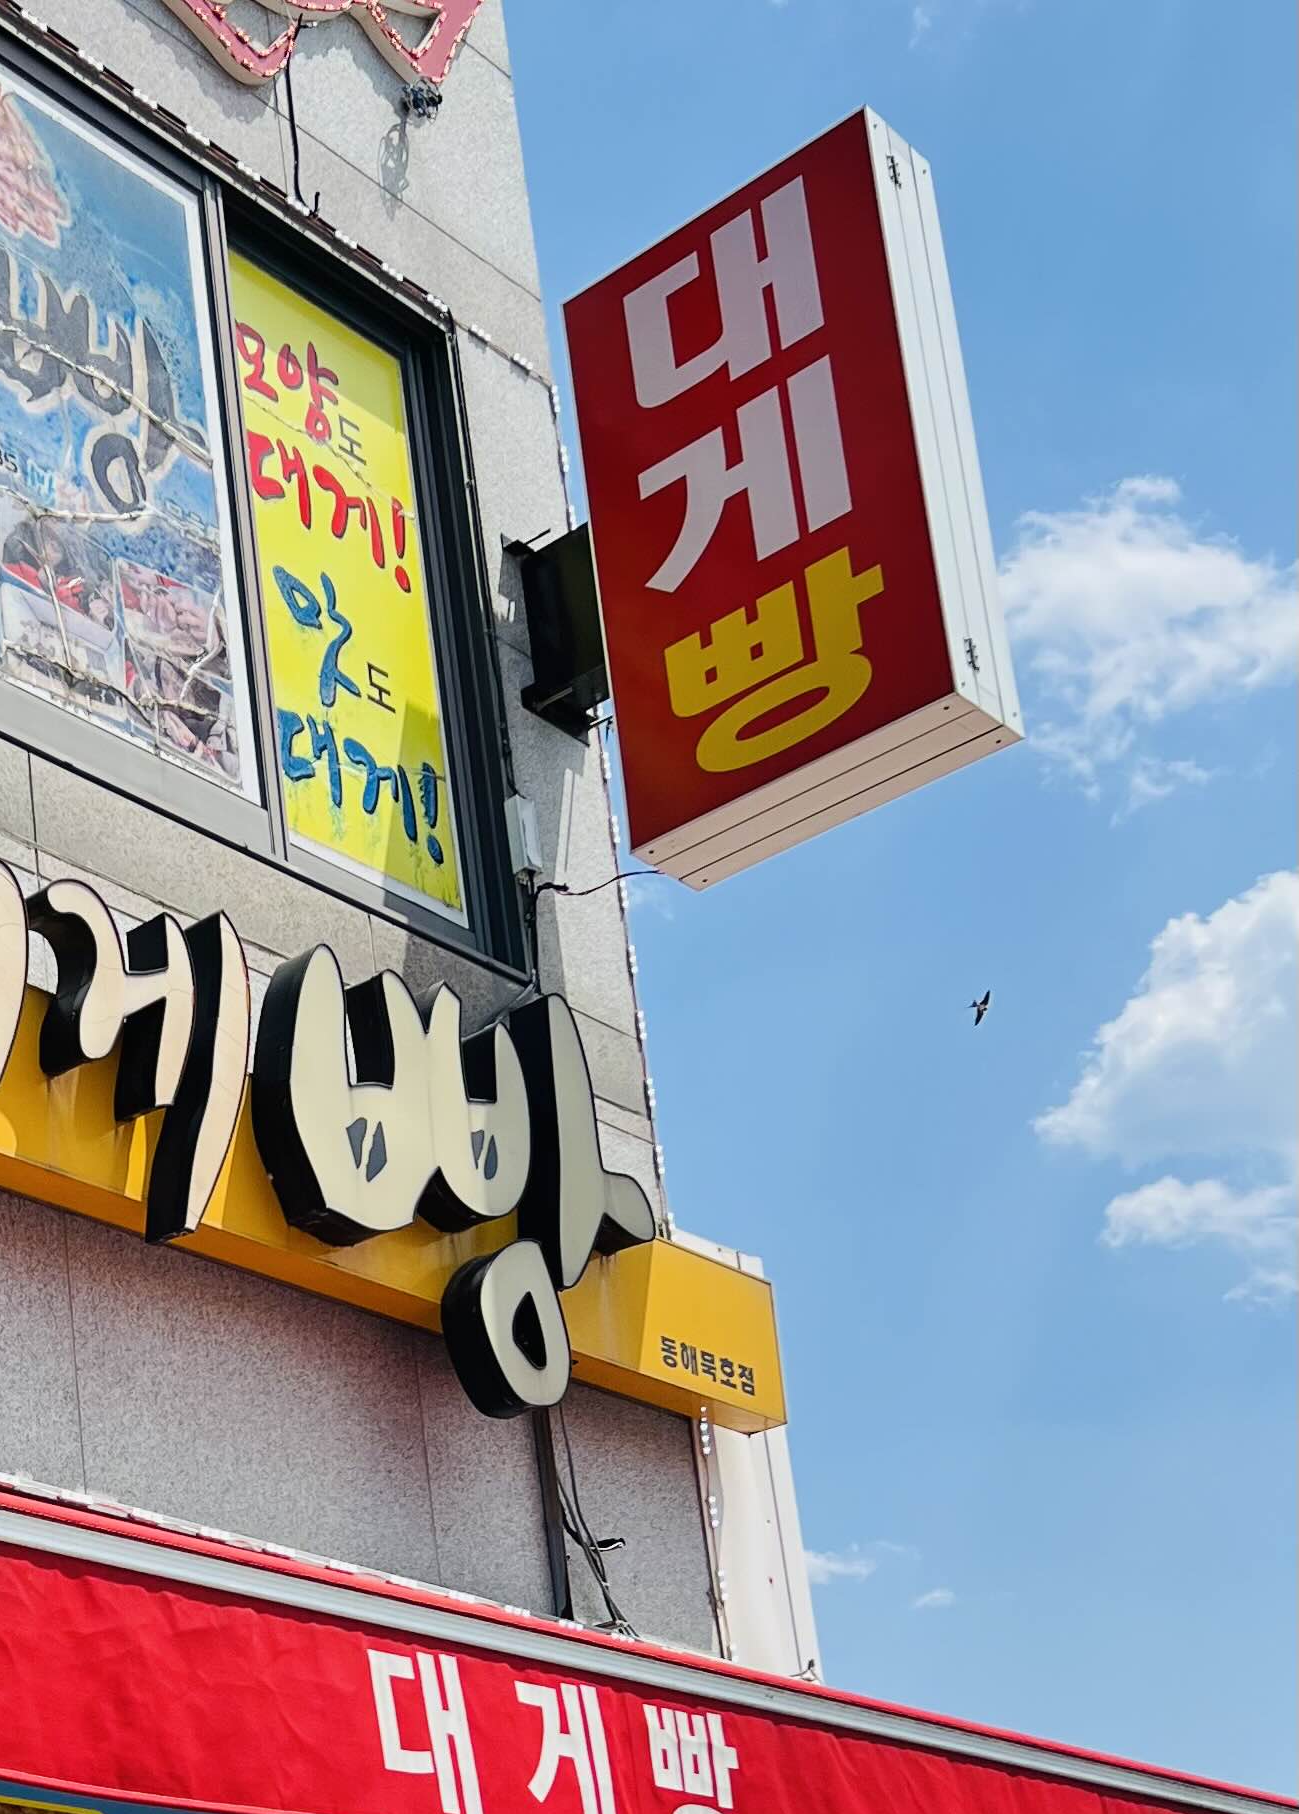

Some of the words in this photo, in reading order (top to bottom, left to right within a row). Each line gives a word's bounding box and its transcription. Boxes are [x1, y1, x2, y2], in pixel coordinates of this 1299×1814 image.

[248, 432, 411, 593] 대게!
[623, 175, 884, 773] 대게빵
[278, 708, 443, 865] 대게!
[661, 1335, 755, 1396] 동해묵호점
